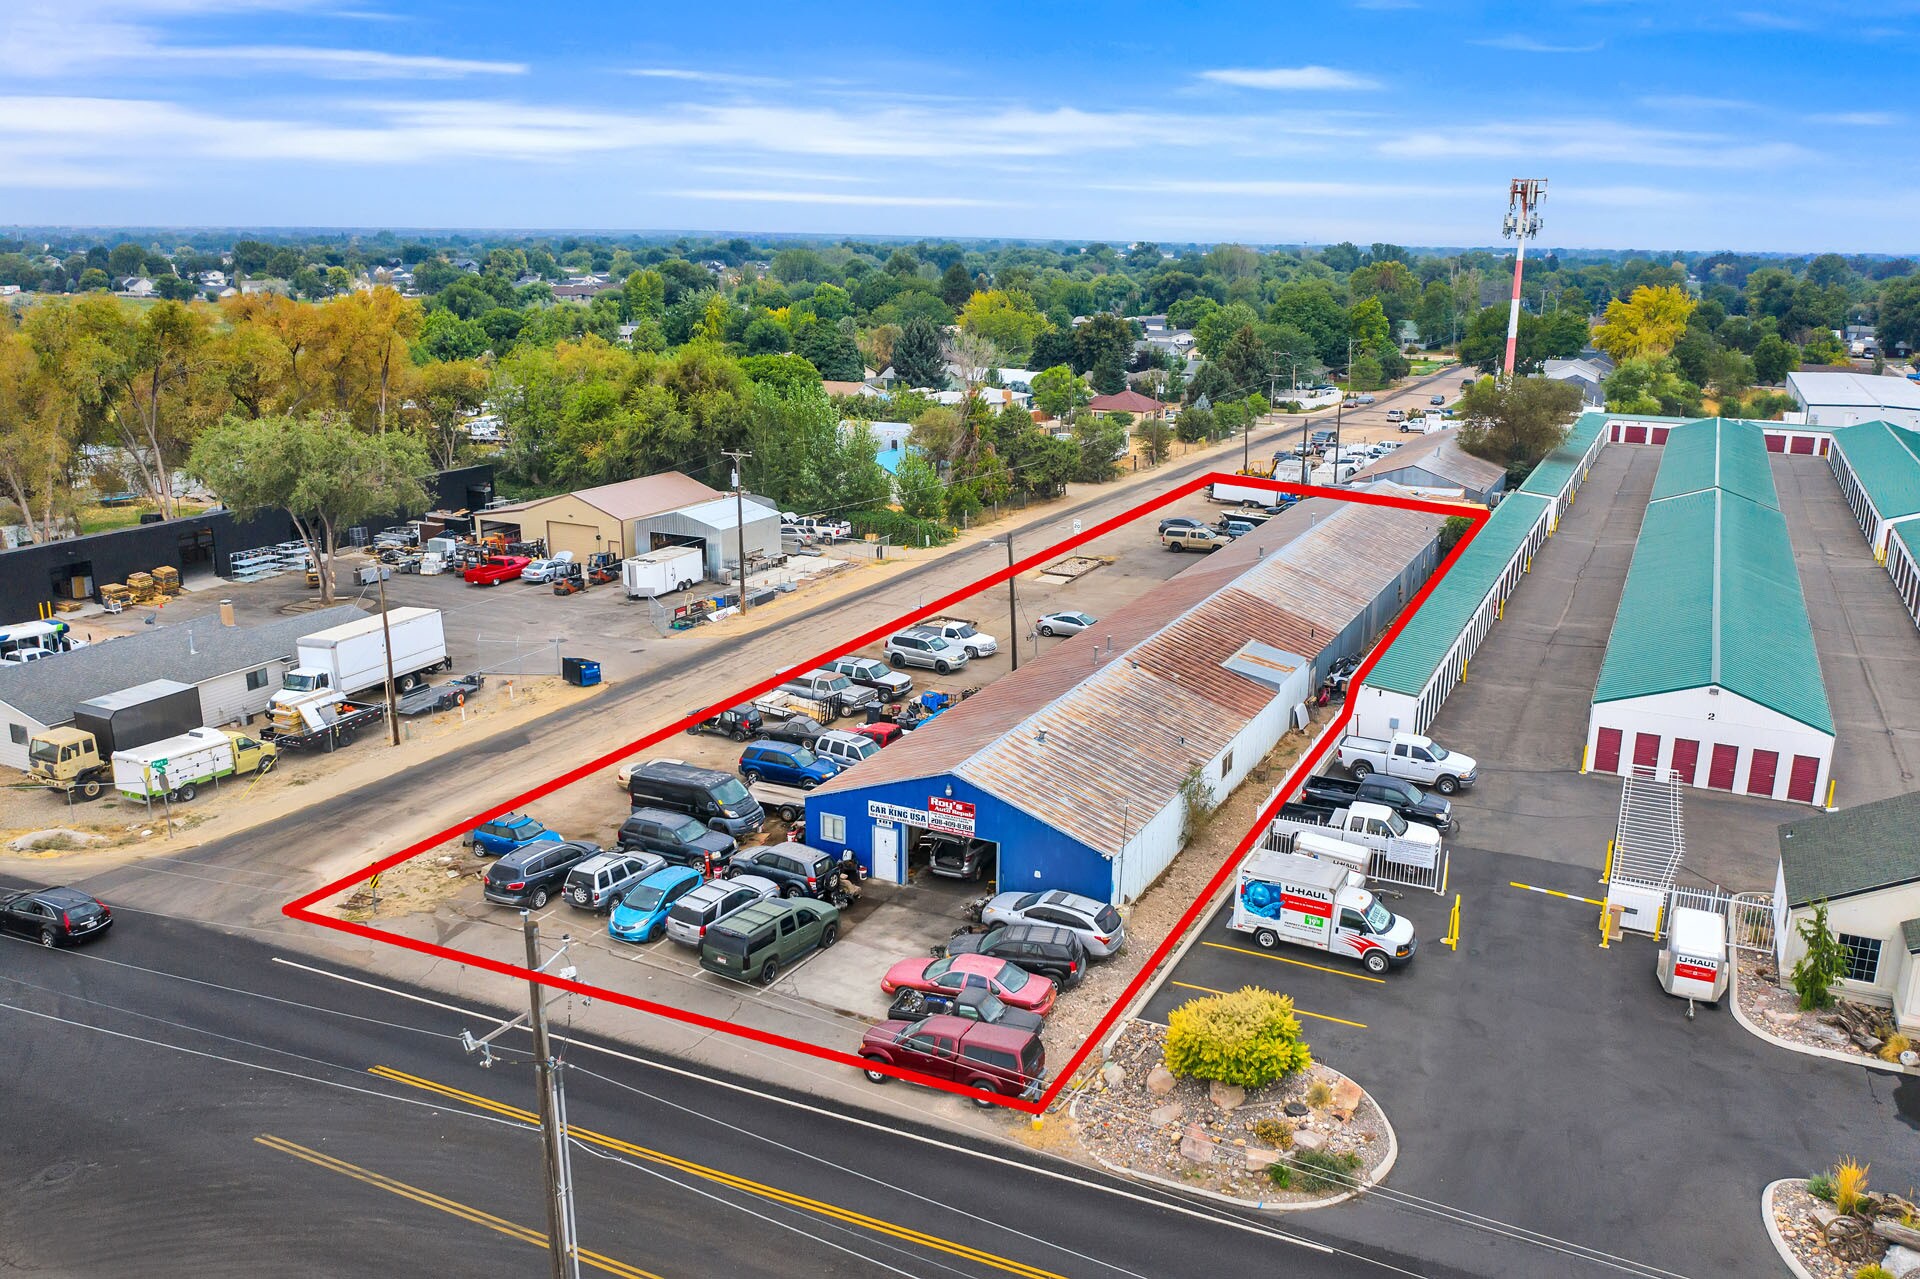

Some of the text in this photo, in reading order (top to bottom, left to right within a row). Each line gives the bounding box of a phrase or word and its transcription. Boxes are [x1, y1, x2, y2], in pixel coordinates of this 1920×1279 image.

[1707, 712, 1715, 721] 2
[930, 797, 963, 811] Roy's
[870, 805, 886, 815] CAR
[888, 808, 908, 819] KING
[910, 812, 927, 823] USA
[935, 806, 974, 818] Auto Repair
[1332, 859, 1359, 871] U-HAUL
[1285, 885, 1328, 901] U-HAUL
[1679, 956, 1716, 968] U-HAUL
